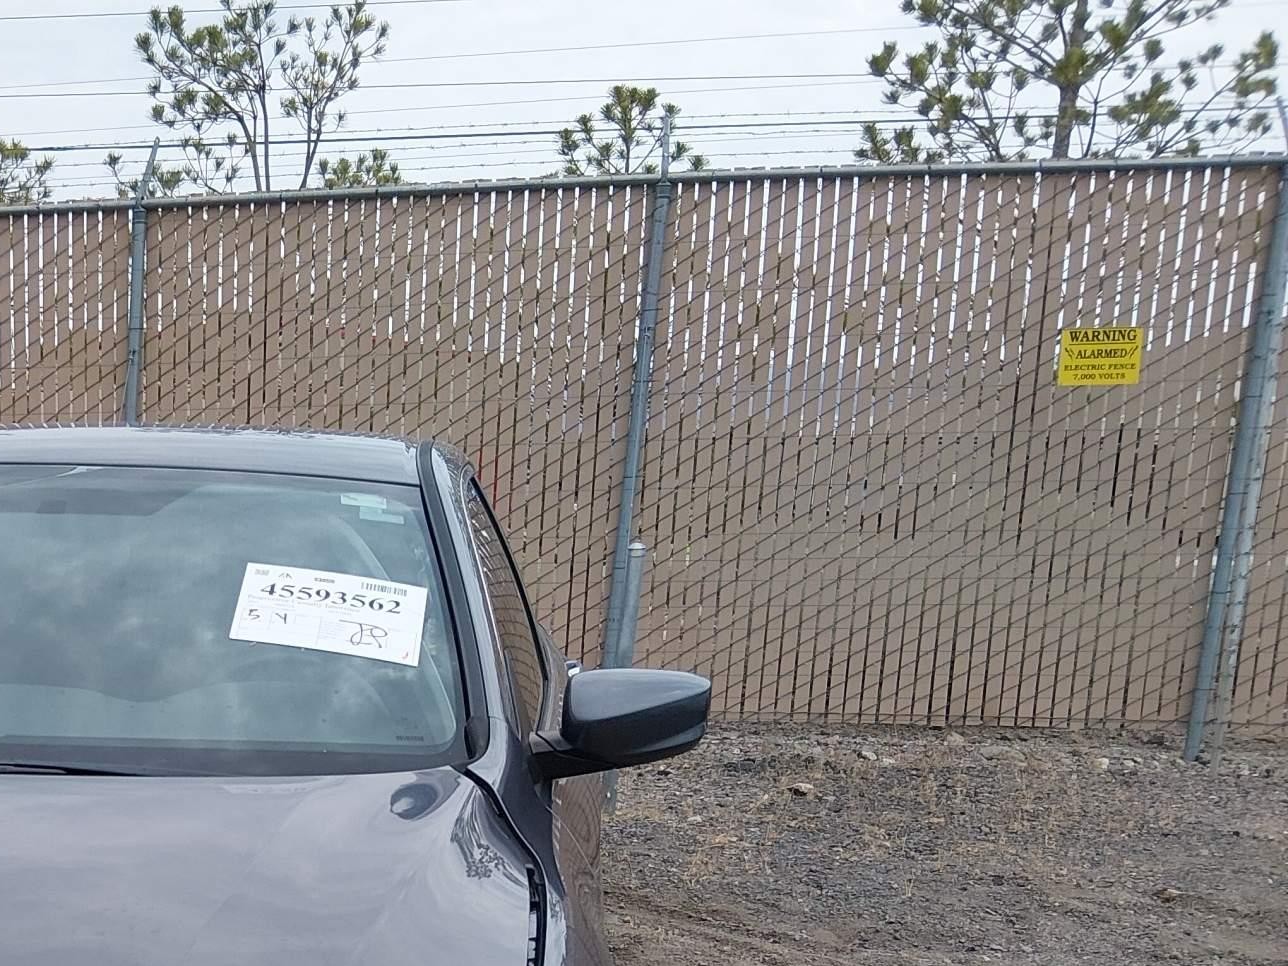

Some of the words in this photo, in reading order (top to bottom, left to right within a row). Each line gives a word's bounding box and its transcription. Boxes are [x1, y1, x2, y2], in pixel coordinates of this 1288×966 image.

[1069, 329, 1138, 343] WARNING
[1075, 348, 1128, 360] ALARMED
[1063, 363, 1106, 372] ELECTRIC
[1107, 362, 1137, 371] FENCE
[1072, 373, 1097, 381] 7,000
[1099, 371, 1127, 380] VOLTS
[260, 583, 401, 615] 45593562
